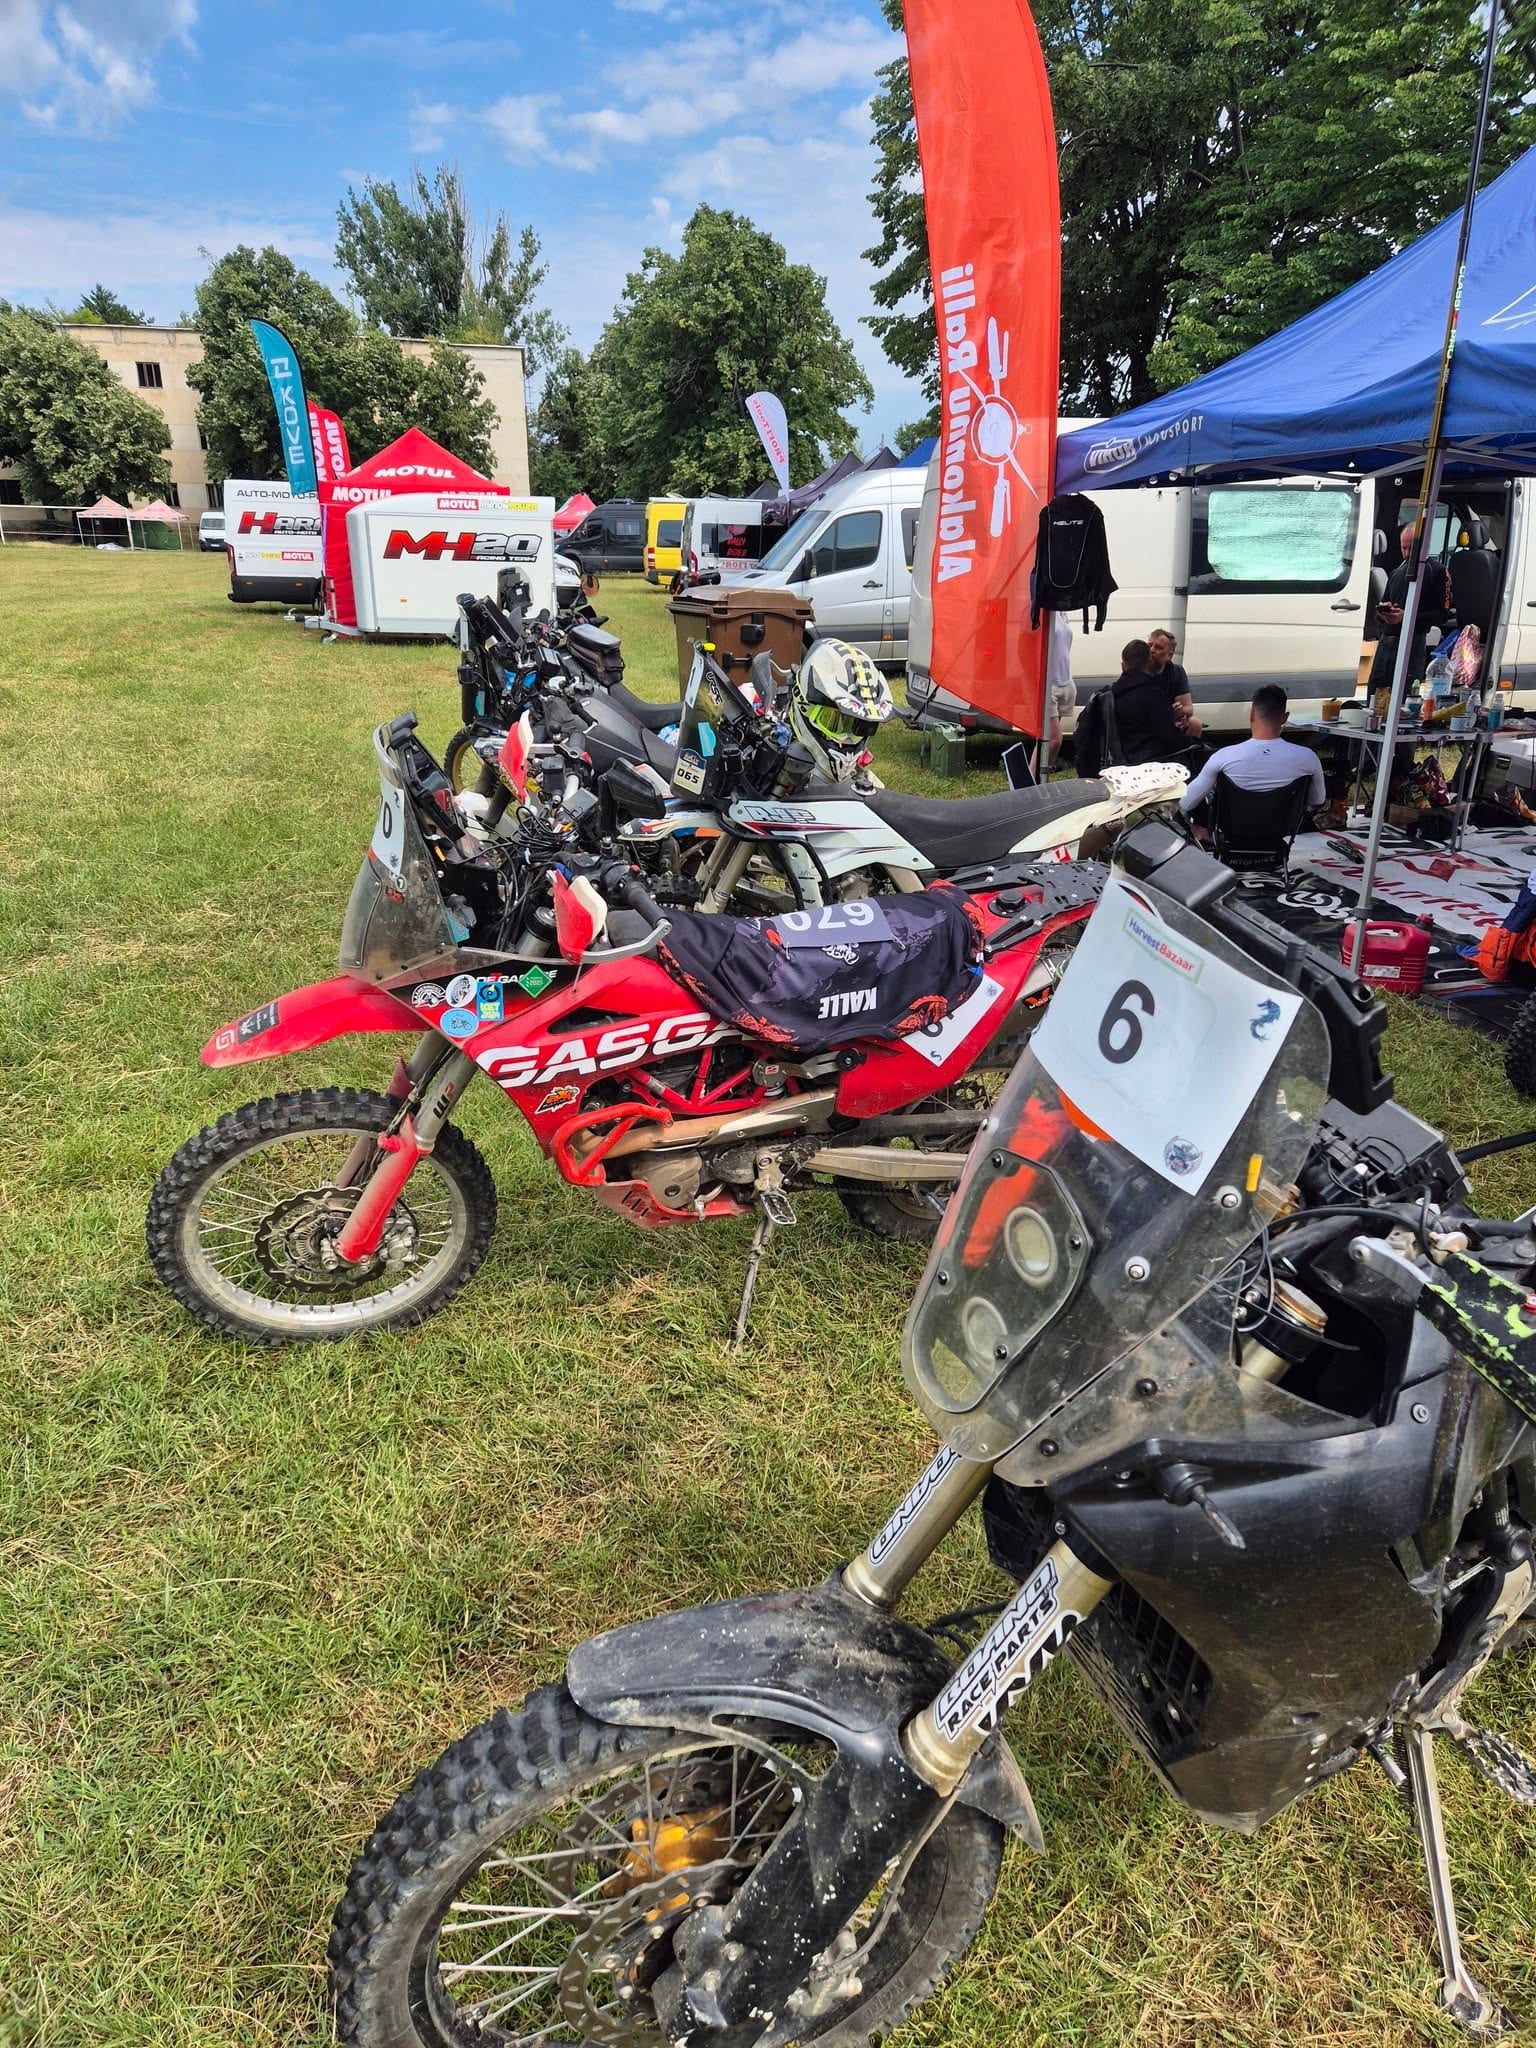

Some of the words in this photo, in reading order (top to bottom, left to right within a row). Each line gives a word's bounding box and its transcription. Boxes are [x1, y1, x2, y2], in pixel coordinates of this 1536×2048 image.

[280, 385, 306, 465] KOVE
[374, 465, 456, 479] MOTUL
[439, 500, 477, 509] MOTUL
[283, 552, 313, 560] MOTUL
[383, 530, 543, 561] MH20
[677, 767, 700, 784] 065
[817, 986, 878, 1020] KALLE
[1098, 979, 1156, 1065] 6
[475, 1012, 748, 1088] GASGA
[873, 1446, 958, 1561] OANO
[948, 1673, 993, 1734] RACE
[996, 1599, 1053, 1671] PARTS
